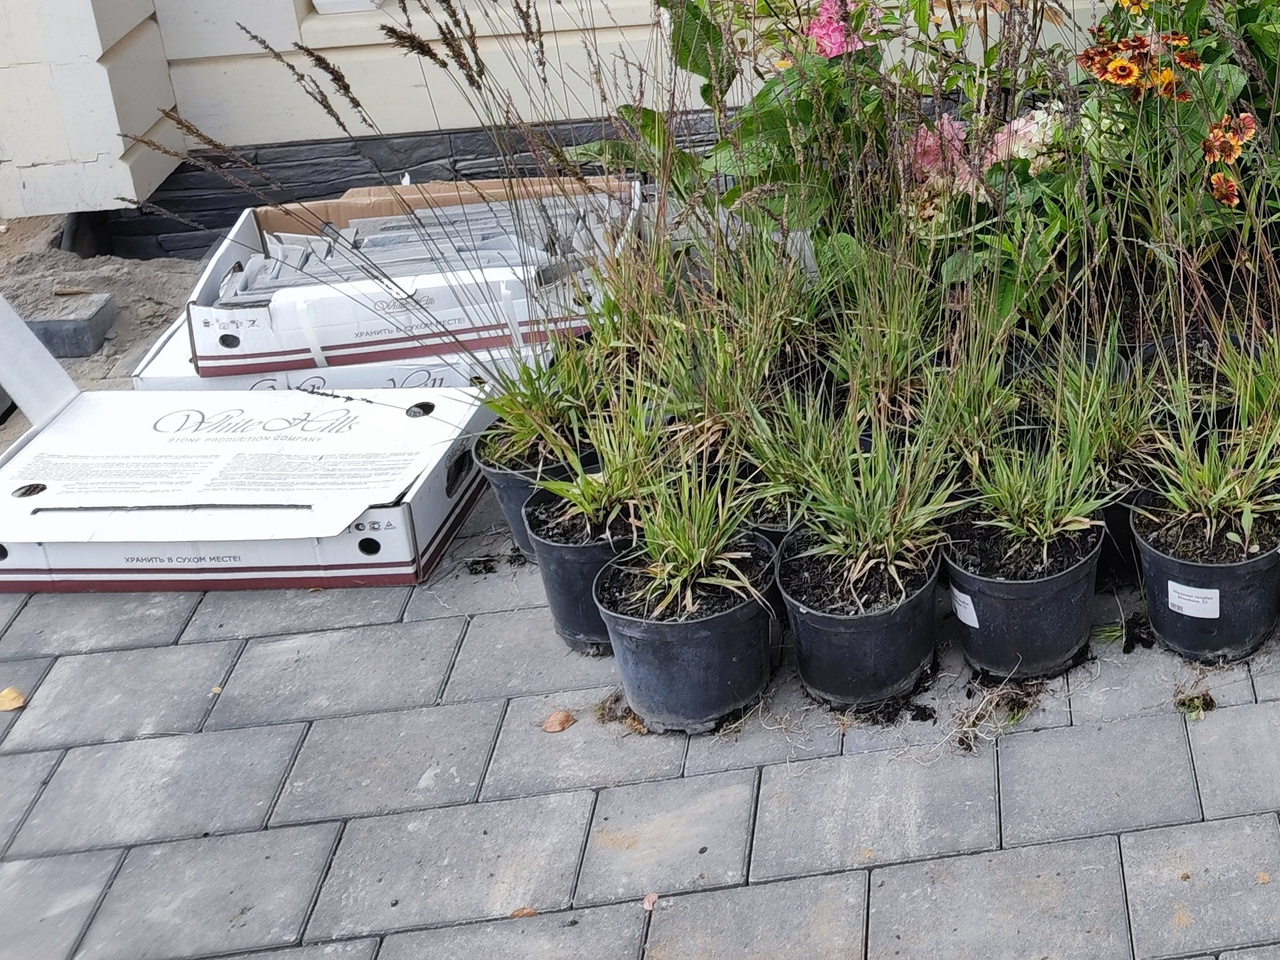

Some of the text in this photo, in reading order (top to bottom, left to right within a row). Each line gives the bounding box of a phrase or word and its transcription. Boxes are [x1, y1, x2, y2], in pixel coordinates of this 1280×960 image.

[354, 327, 394, 339] ХРАНИТЬ
[152, 408, 360, 434] White Hills
[203, 435, 271, 443] PRODUCTION
[124, 555, 241, 564] ХРАНИТЬ В СУХОМ МЕСТЕ!
